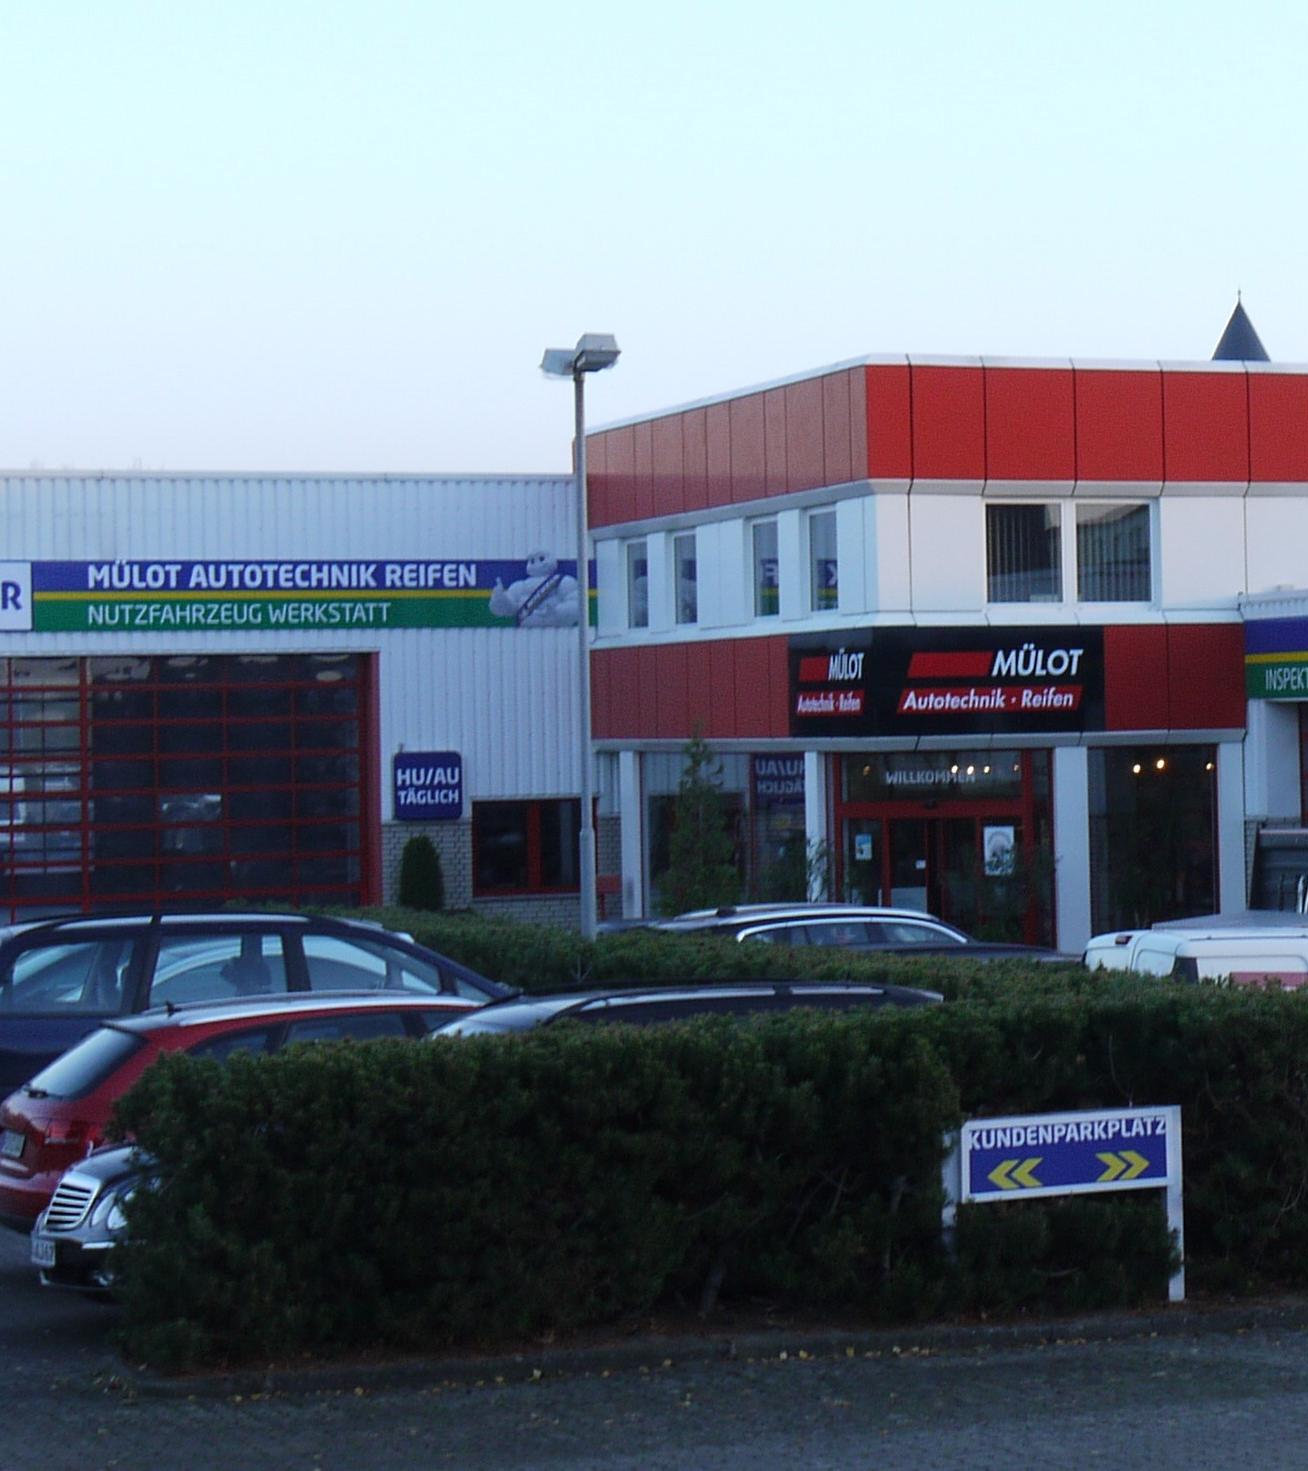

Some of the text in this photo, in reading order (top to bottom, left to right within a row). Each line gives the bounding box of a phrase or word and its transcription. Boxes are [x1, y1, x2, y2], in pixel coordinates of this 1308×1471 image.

[88, 560, 477, 589] MÜLOT AUTOTECHNIK REIFEN
[87, 602, 391, 625] NUTZFAHRZEUG WERKSTATT
[828, 648, 864, 680] MÜLOT
[991, 643, 1084, 677] MÜLOT
[903, 687, 1074, 710] Autotechnik Reifen
[397, 767, 459, 786] HU/AU
[398, 787, 459, 805] TÄGLICH
[969, 1115, 1166, 1150] KUNDENPARKPLATZ
